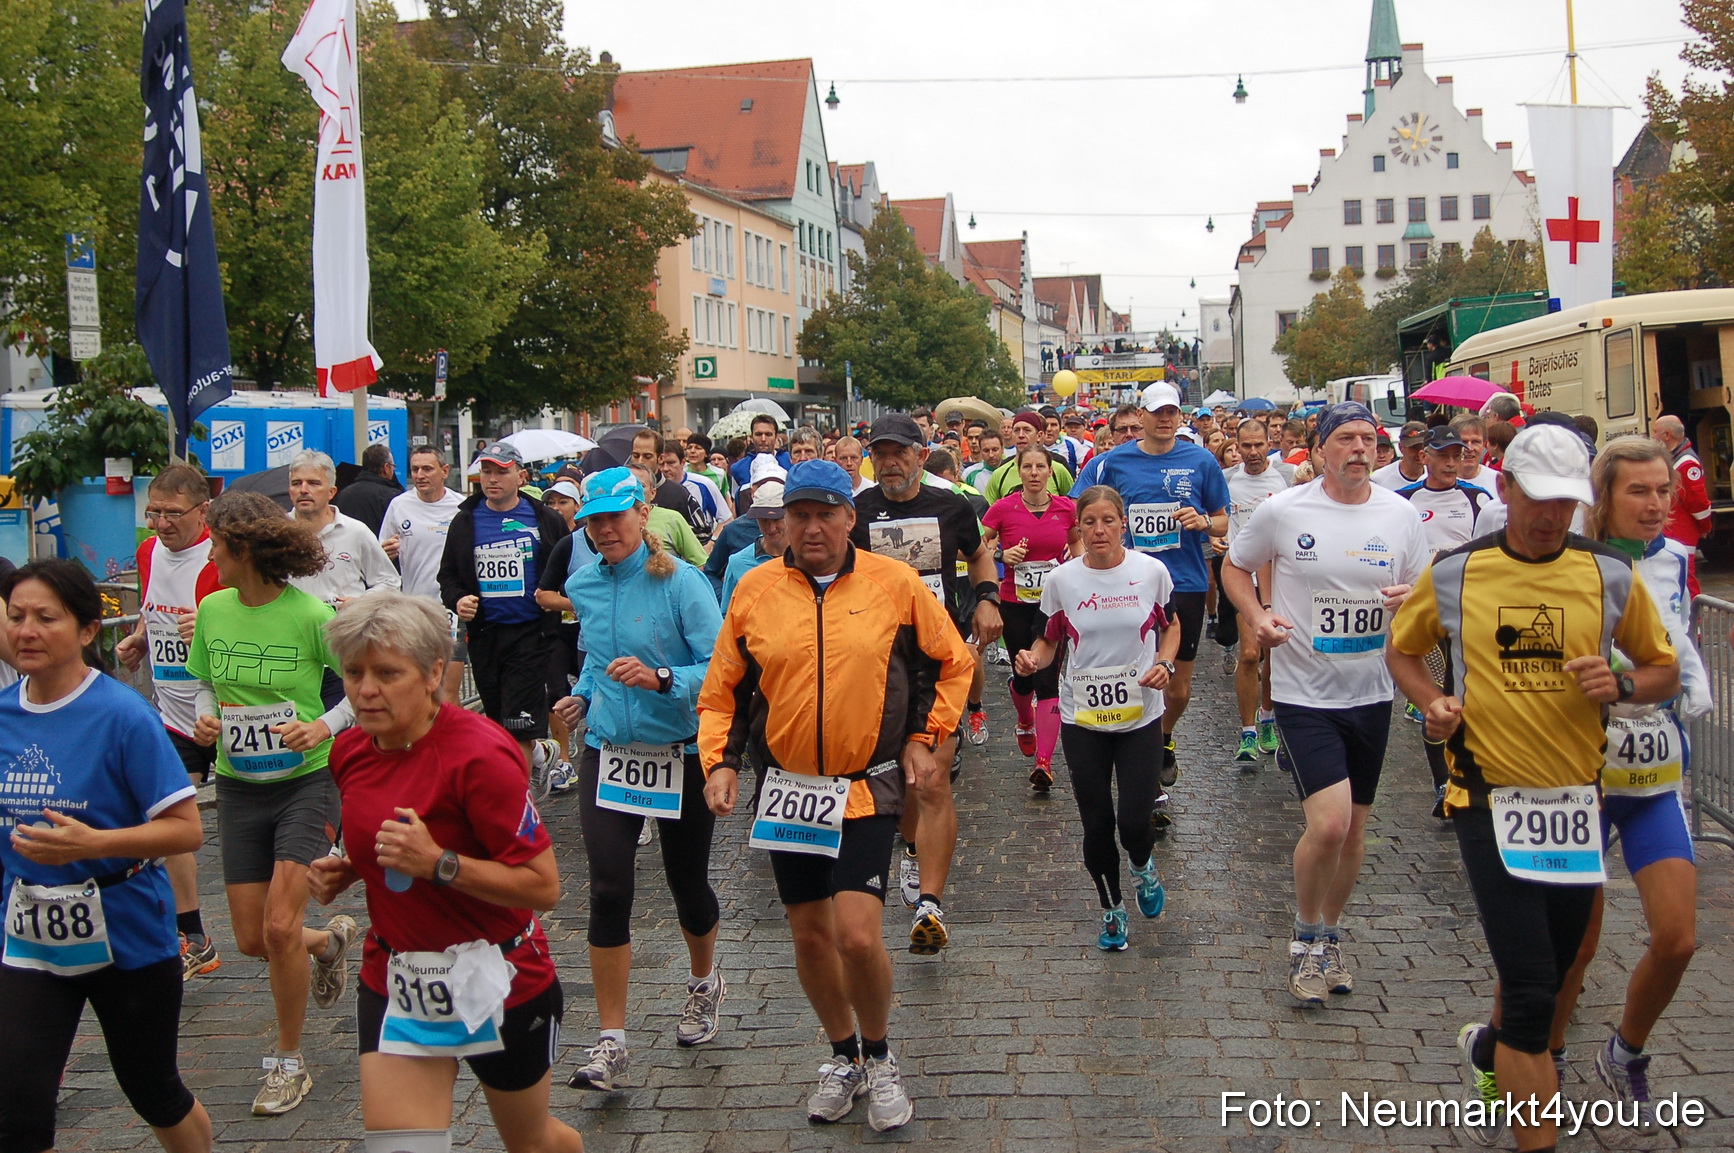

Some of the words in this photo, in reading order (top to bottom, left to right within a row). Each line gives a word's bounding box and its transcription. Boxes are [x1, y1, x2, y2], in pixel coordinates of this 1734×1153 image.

[697, 359, 713, 375] D
[1528, 350, 1578, 378] Bayerisches
[1528, 381, 1552, 399] Rotes
[1135, 515, 1177, 534] 2660
[477, 560, 518, 578] 2866
[1101, 594, 1139, 603] MÜNCHEN
[1101, 602, 1140, 610] MARATHON
[1320, 607, 1383, 634] 3180
[1321, 637, 1375, 653] FRANK
[163, 669, 195, 678] Manfre
[1501, 660, 1562, 674] HIRSCH
[1073, 674, 1094, 682] PARTL
[1094, 672, 1128, 681] Neumarkt
[1086, 681, 1128, 708] 386
[244, 711, 281, 721] Neumarkt
[1096, 712, 1121, 722] Heike
[602, 744, 628, 755] PARTL
[630, 749, 669, 757] Neumarkt
[1617, 730, 1669, 764] 430
[244, 758, 284, 770] Daniela
[608, 757, 672, 788] 2601
[1628, 771, 1657, 785] Berta
[766, 776, 792, 787] PARTL
[795, 781, 832, 791] Neumarkt
[42, 798, 88, 809] Stadtlauf
[624, 791, 652, 806] Petra
[1493, 796, 1528, 804] PARTL
[1530, 797, 1580, 805] Neumarkt
[765, 788, 837, 826] 2602
[774, 826, 817, 842] Werner
[1504, 809, 1590, 846] 2908
[1532, 855, 1568, 869] Franz
